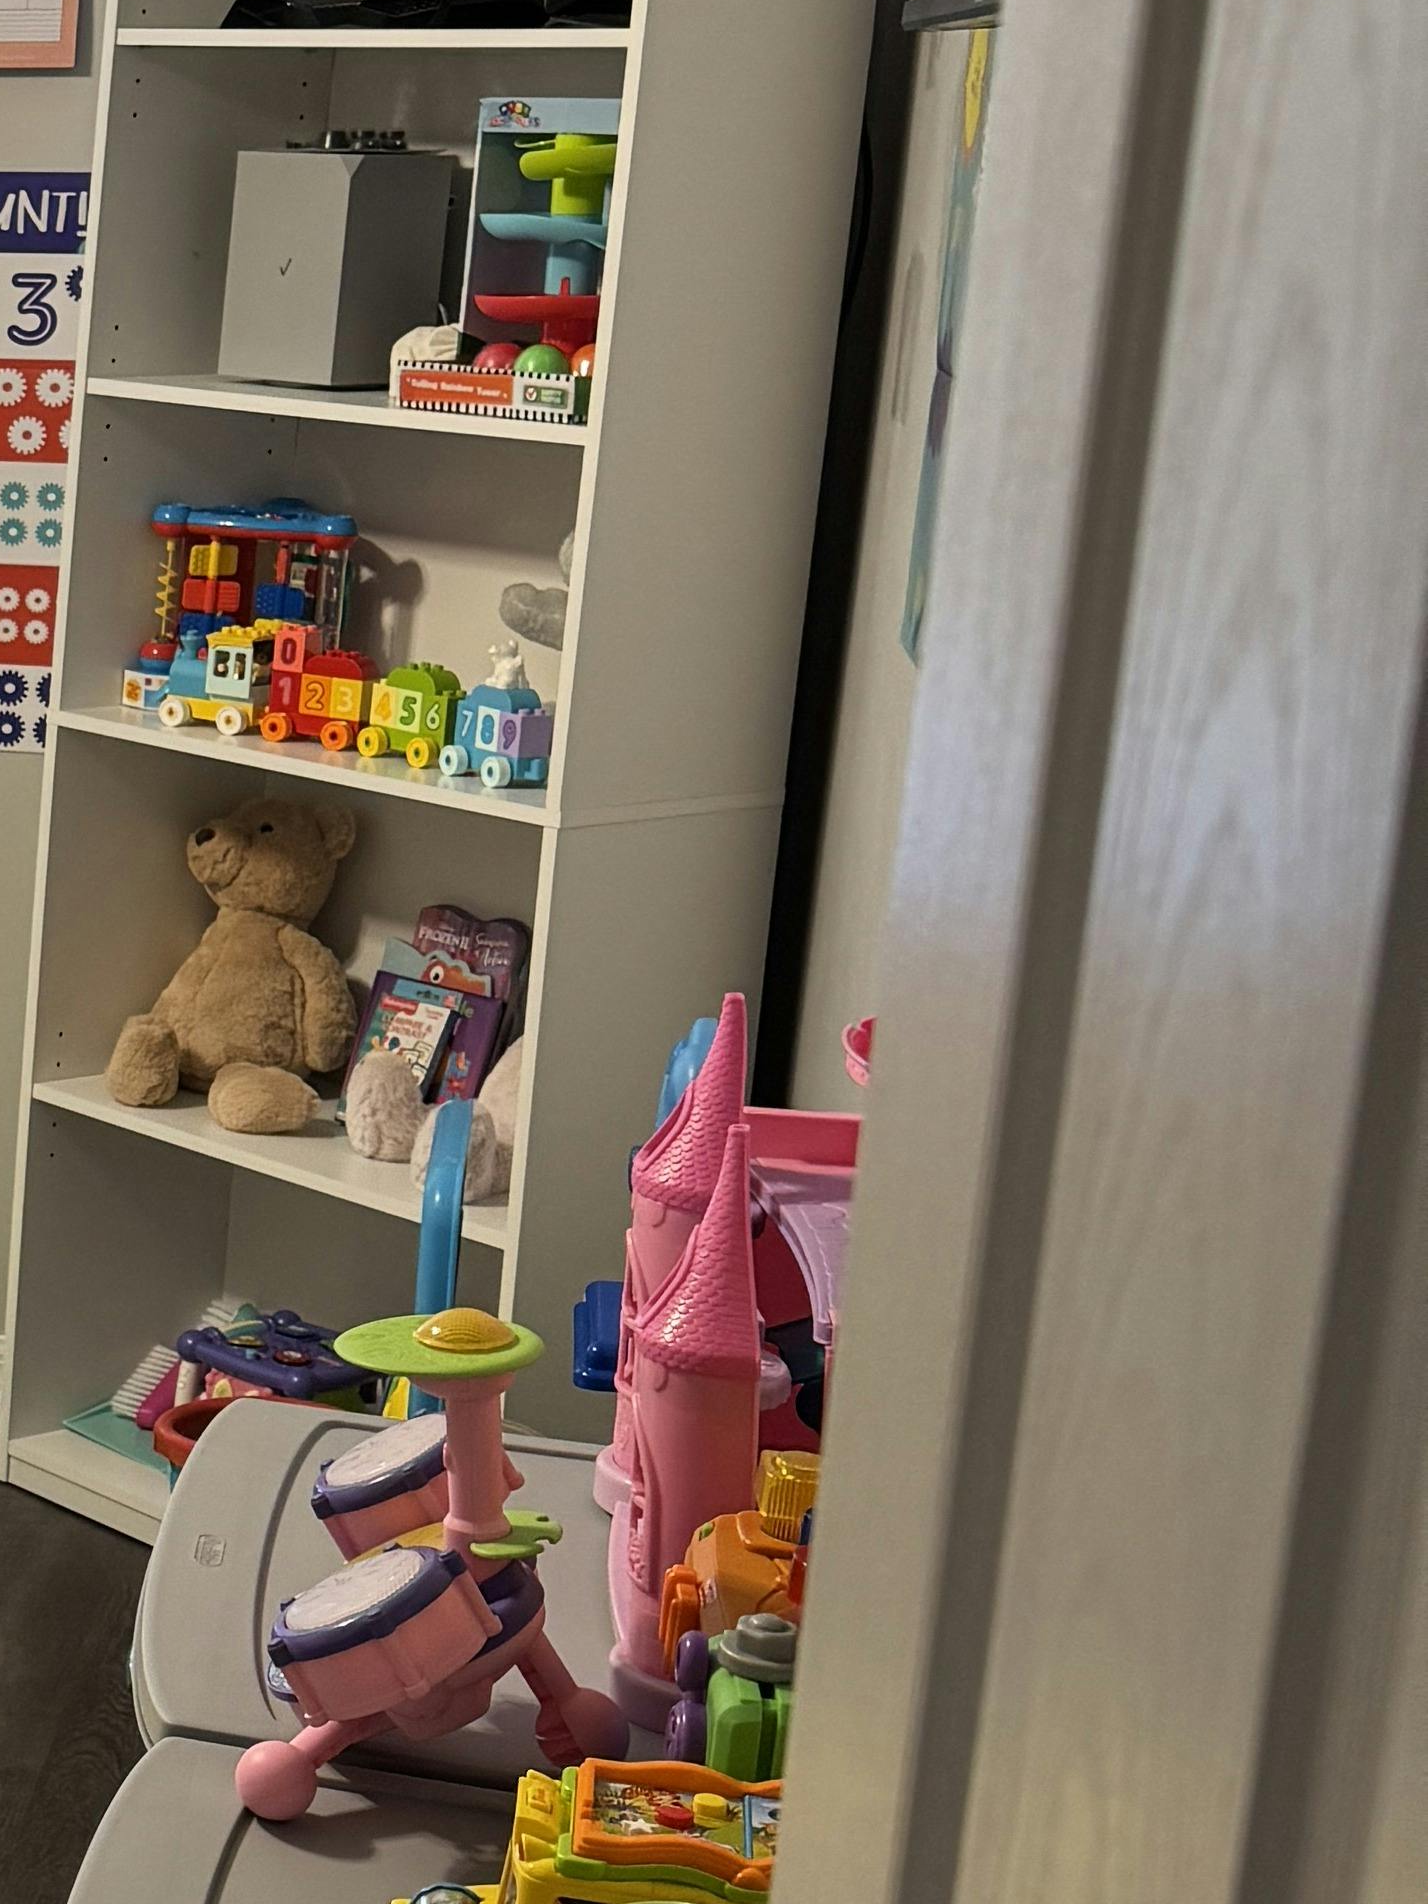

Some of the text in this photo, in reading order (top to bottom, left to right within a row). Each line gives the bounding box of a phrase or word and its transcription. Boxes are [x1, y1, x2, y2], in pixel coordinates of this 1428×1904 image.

[7, 273, 57, 346] 3
[281, 638, 295, 664] 0
[278, 677, 352, 712] 1 2 3
[375, 692, 441, 729] 4 5 6
[461, 710, 517, 750] 7 8 9
